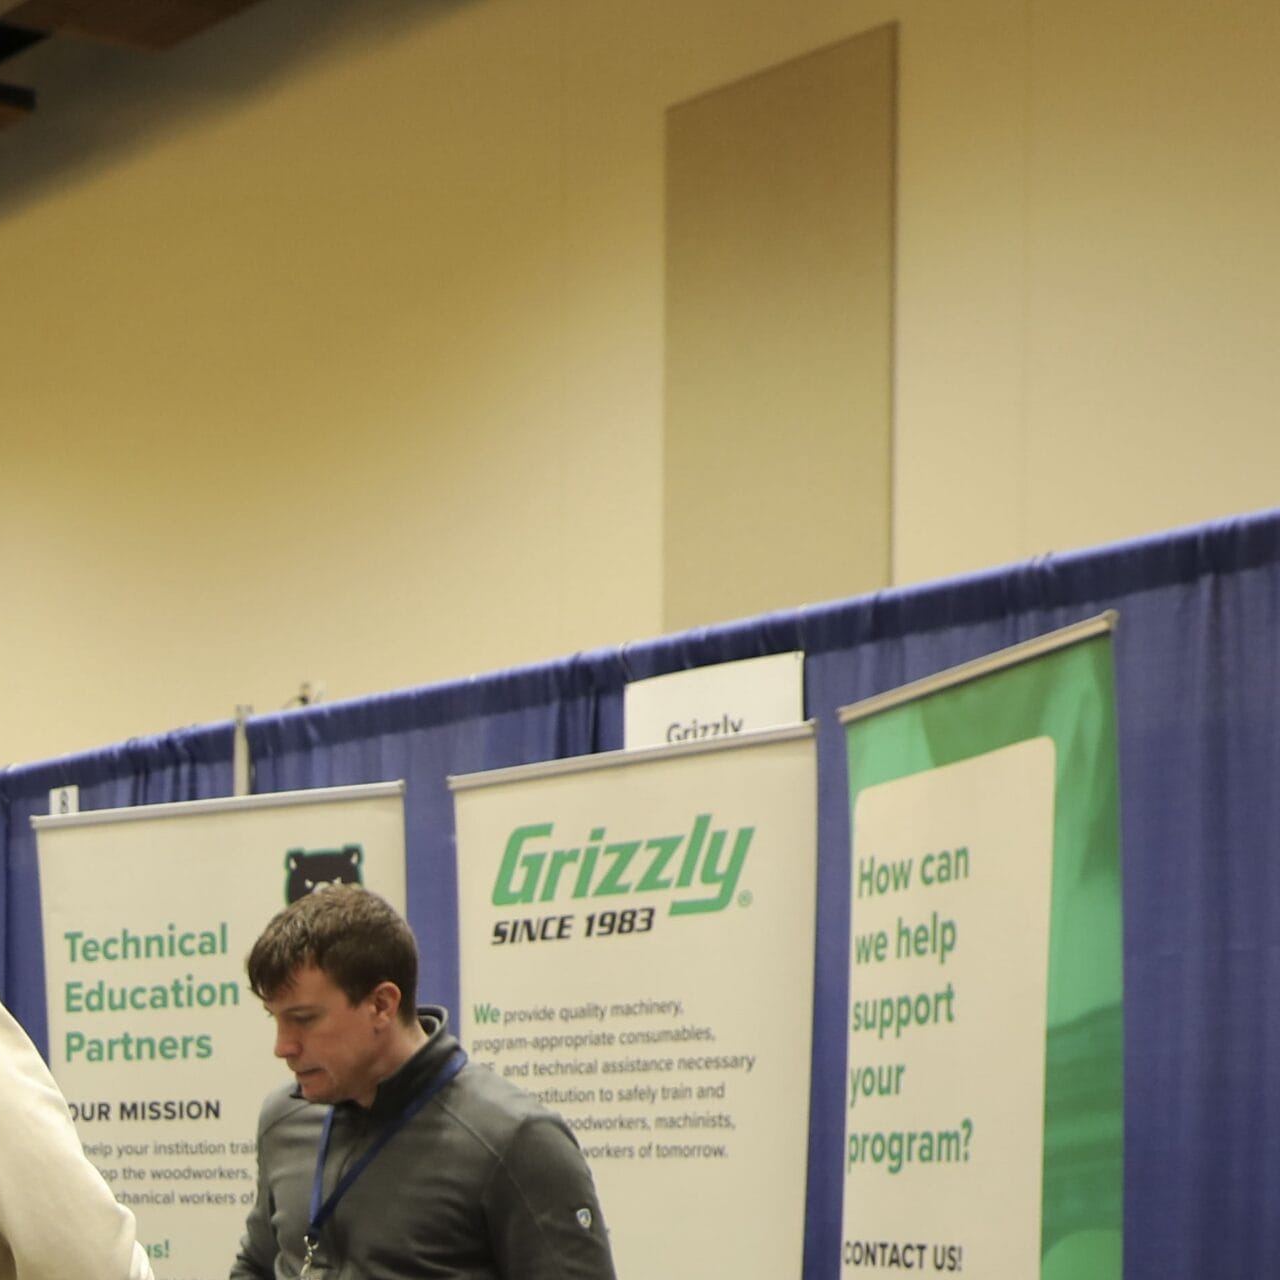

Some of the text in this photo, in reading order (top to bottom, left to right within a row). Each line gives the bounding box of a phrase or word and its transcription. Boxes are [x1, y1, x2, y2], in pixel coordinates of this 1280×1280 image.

[666, 714, 743, 743] Grizzly
[491, 814, 755, 917] Grizzly
[858, 846, 969, 899] How can
[491, 908, 655, 945] SINCE 1983
[855, 911, 957, 964] we help
[64, 922, 228, 962] Technical
[65, 975, 239, 1013] Education
[473, 999, 684, 1026] We provide quality machinery,
[852, 982, 955, 1039] support
[65, 1031, 213, 1063] Partners
[471, 1025, 716, 1054] program-appropriate consumables,
[503, 1061, 529, 1077] and
[533, 1058, 598, 1076] technical
[601, 1055, 673, 1074] assistance
[677, 1053, 756, 1073] necessary
[599, 1087, 614, 1102] to
[618, 1083, 659, 1104] safely
[661, 1083, 693, 1100] train
[696, 1081, 725, 1100] and
[850, 1064, 905, 1108] your
[120, 1100, 221, 1121] MISSION
[567, 1113, 736, 1133] oodworkers, machinists,
[116, 1143, 149, 1159] your
[154, 1138, 226, 1156] institution
[229, 1138, 258, 1155] trai
[638, 1142, 654, 1160] of
[656, 1142, 729, 1160] tomorrow.
[848, 1118, 973, 1174] program?
[122, 1165, 146, 1181] the
[151, 1164, 253, 1181] woodworkers,
[116, 1190, 175, 1206] chanical
[179, 1187, 237, 1205] workers
[843, 1240, 963, 1271] CONTACT US!
